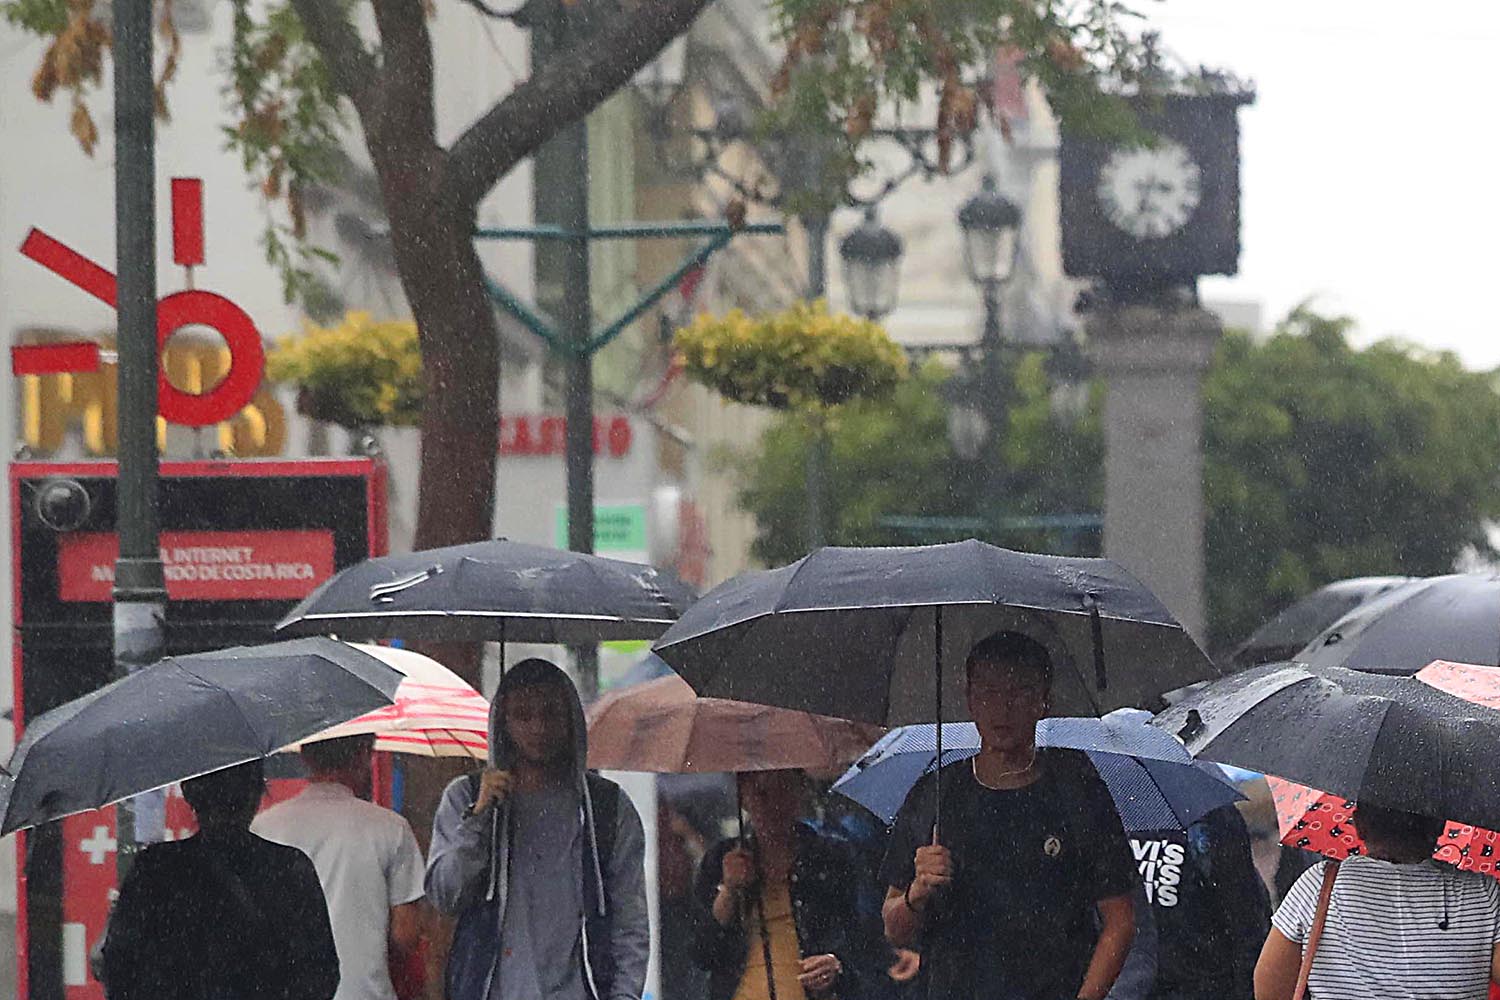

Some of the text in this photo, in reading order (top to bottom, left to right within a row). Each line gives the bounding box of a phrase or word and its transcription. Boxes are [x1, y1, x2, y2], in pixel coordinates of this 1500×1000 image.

[174, 547, 254, 563] INTERNET
[222, 564, 274, 580] COSTA
[275, 563, 314, 580] RICA
[1129, 839, 1185, 866] VI'S
